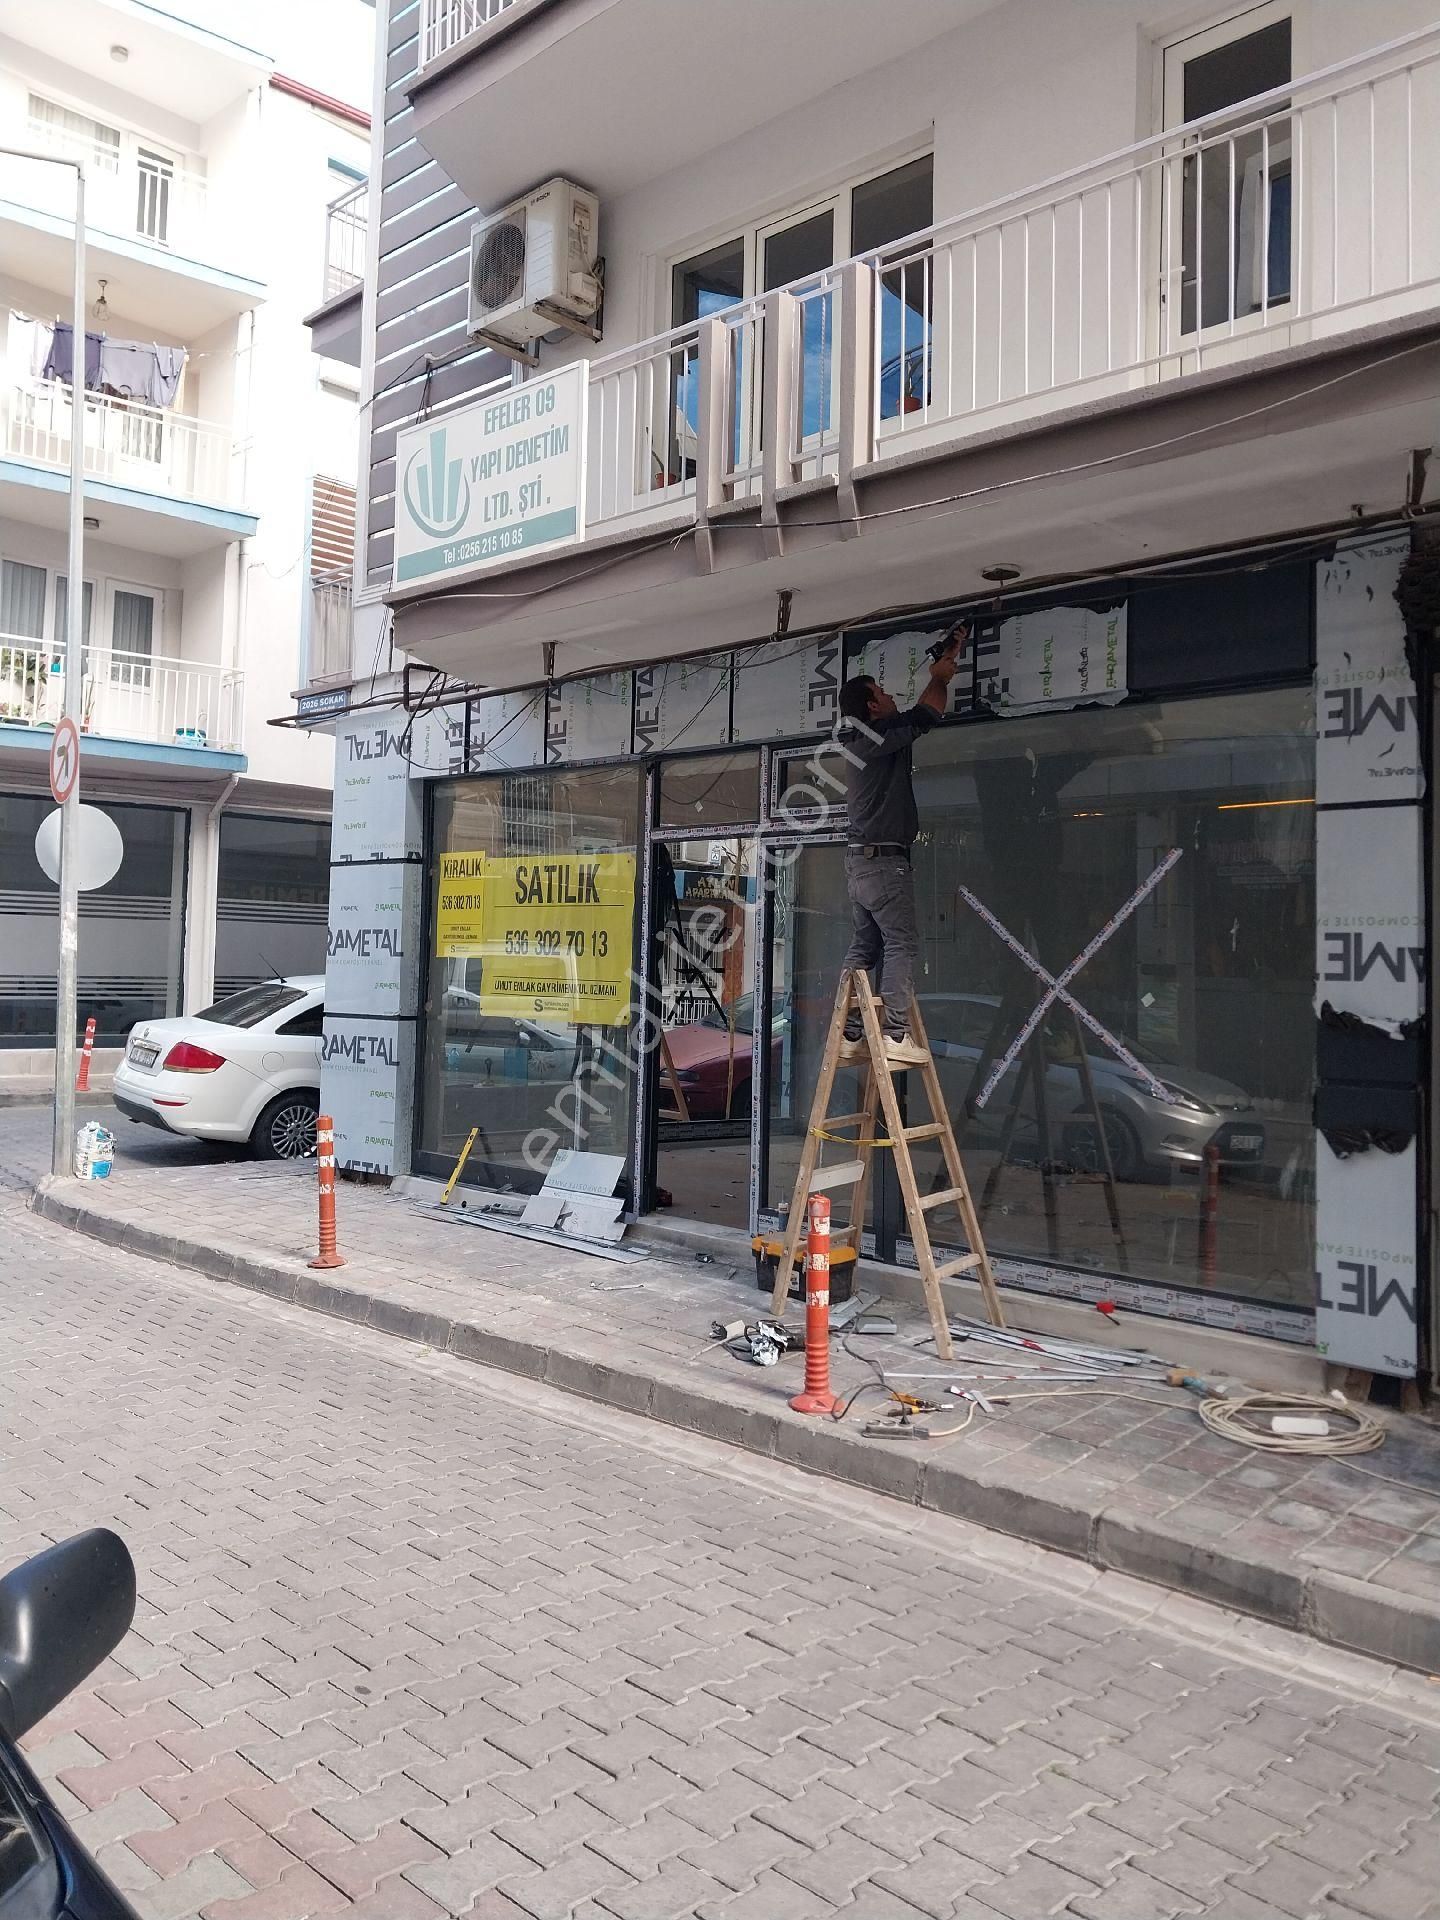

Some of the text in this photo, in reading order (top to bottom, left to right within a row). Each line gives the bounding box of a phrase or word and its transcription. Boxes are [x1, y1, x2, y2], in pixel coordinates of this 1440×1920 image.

[484, 384, 556, 436] EFELER 09
[470, 424, 569, 483] YAPI DENETİM
[484, 490, 513, 523] LTD.
[482, 537, 497, 555] 215
[500, 532, 510, 550] 10
[512, 528, 523, 545] 85
[301, 700, 319, 710] 2026
[319, 694, 344, 706] SOKAK
[515, 863, 601, 904] SATILIK
[442, 895, 481, 910] 536 302 70 13
[505, 930, 529, 955] 536
[534, 930, 561, 956] 302
[565, 931, 585, 957] 70
[591, 931, 608, 957] 13
